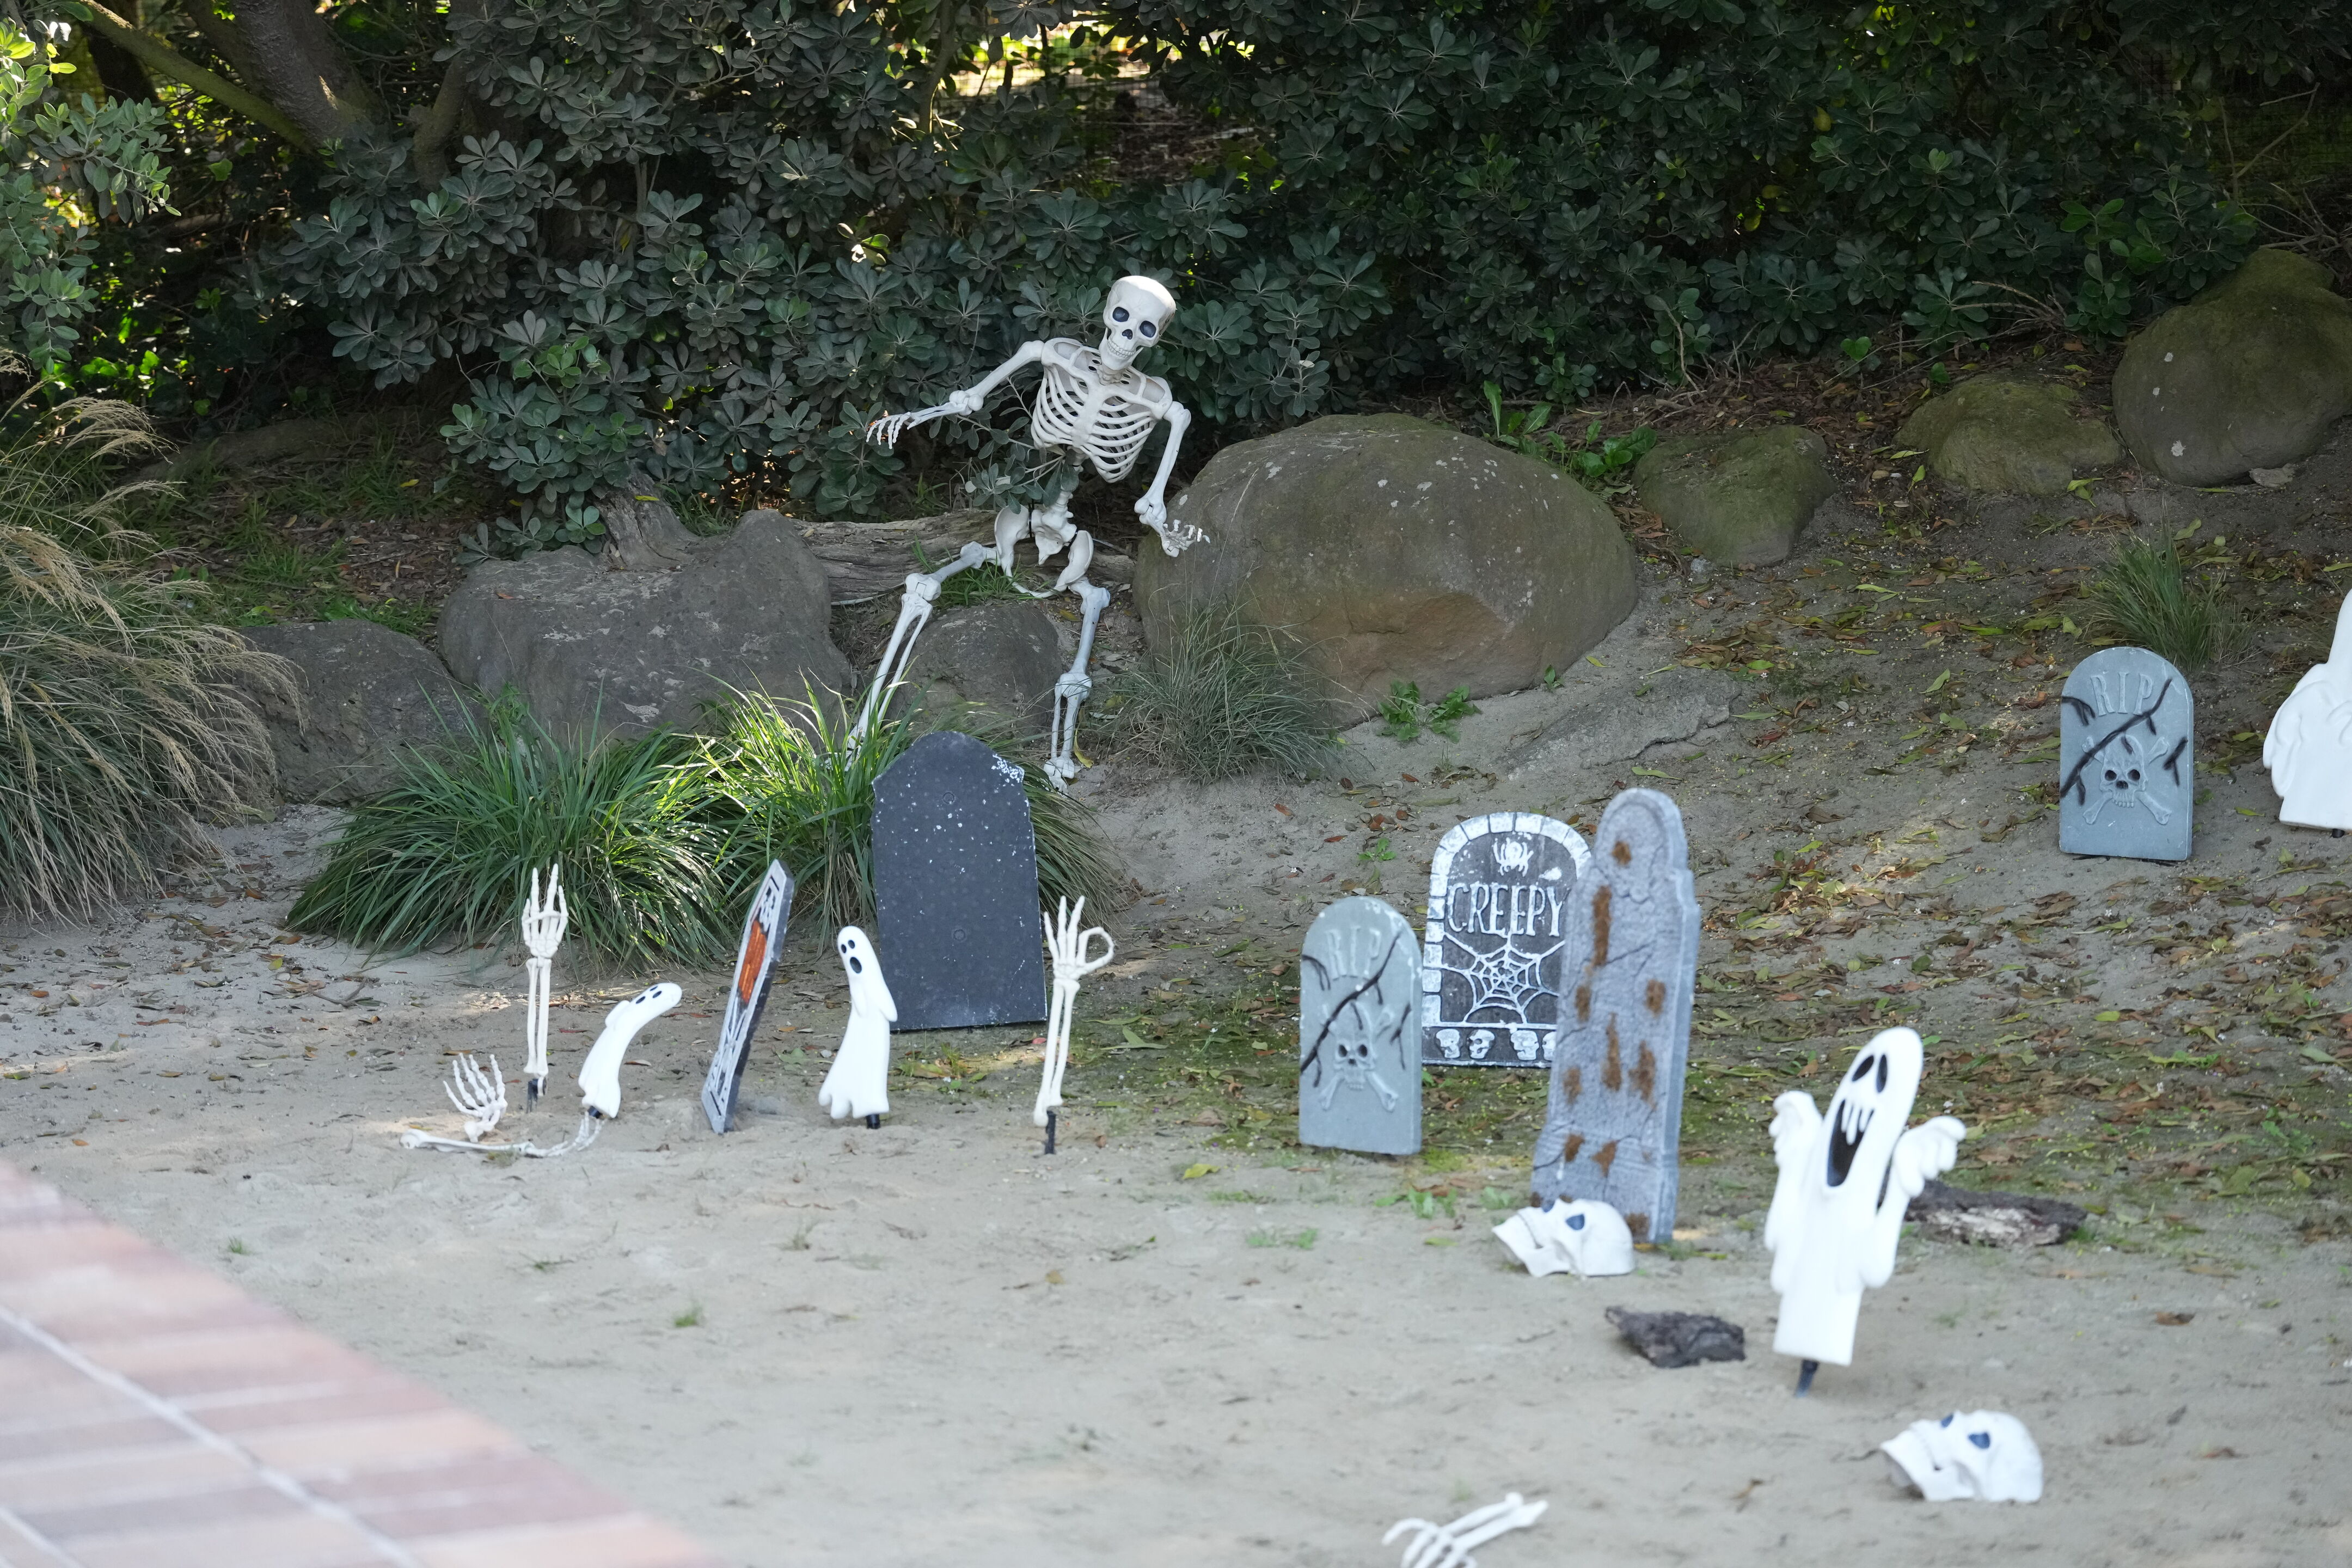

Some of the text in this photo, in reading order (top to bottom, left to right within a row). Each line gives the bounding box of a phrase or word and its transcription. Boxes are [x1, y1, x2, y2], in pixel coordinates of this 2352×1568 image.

[2090, 671, 2153, 716] RIP
[1447, 881, 1571, 937] CREEPY
[1325, 925, 1382, 981] RIP
